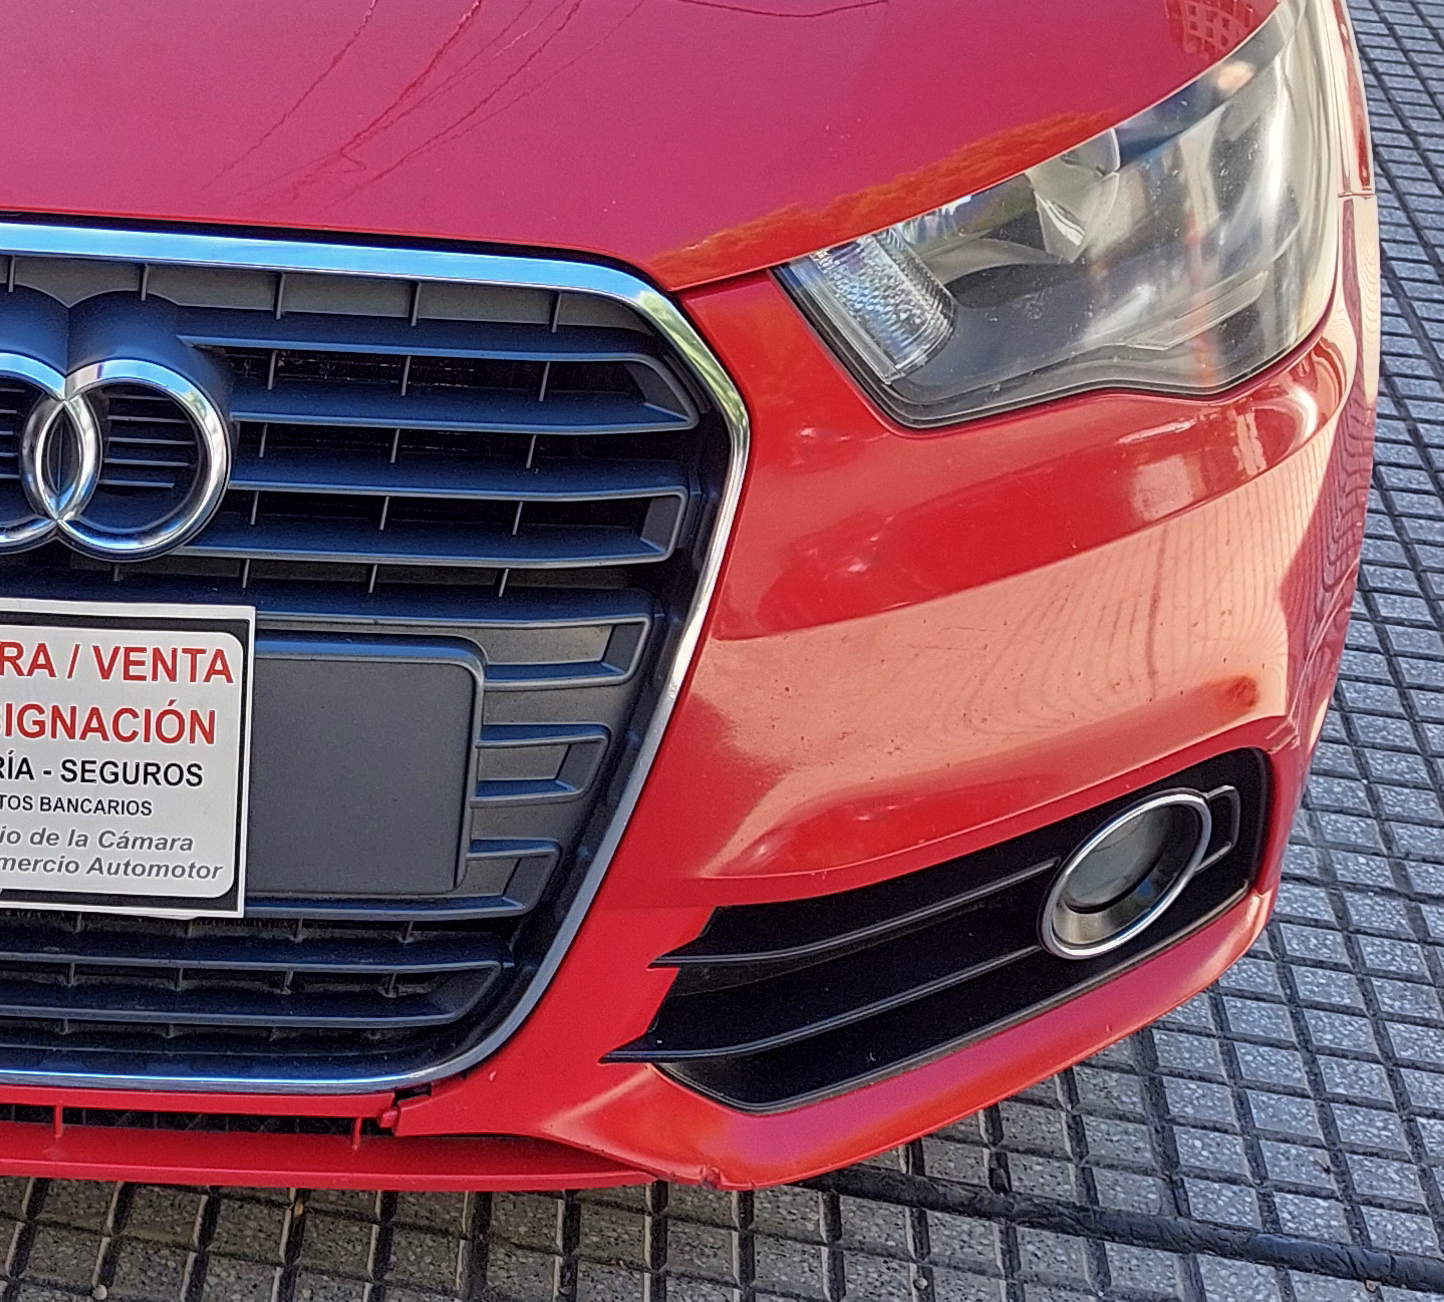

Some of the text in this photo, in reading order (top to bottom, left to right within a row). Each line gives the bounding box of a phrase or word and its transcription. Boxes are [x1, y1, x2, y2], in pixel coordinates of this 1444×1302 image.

[67, 643, 81, 680] /
[92, 644, 235, 684] VENTA
[59, 758, 204, 788] SEGUROS
[39, 795, 154, 817] BANCARIOS
[28, 825, 61, 848] de
[67, 827, 90, 849] la
[97, 828, 195, 853] Cámara
[86, 856, 225, 882] Automotor
